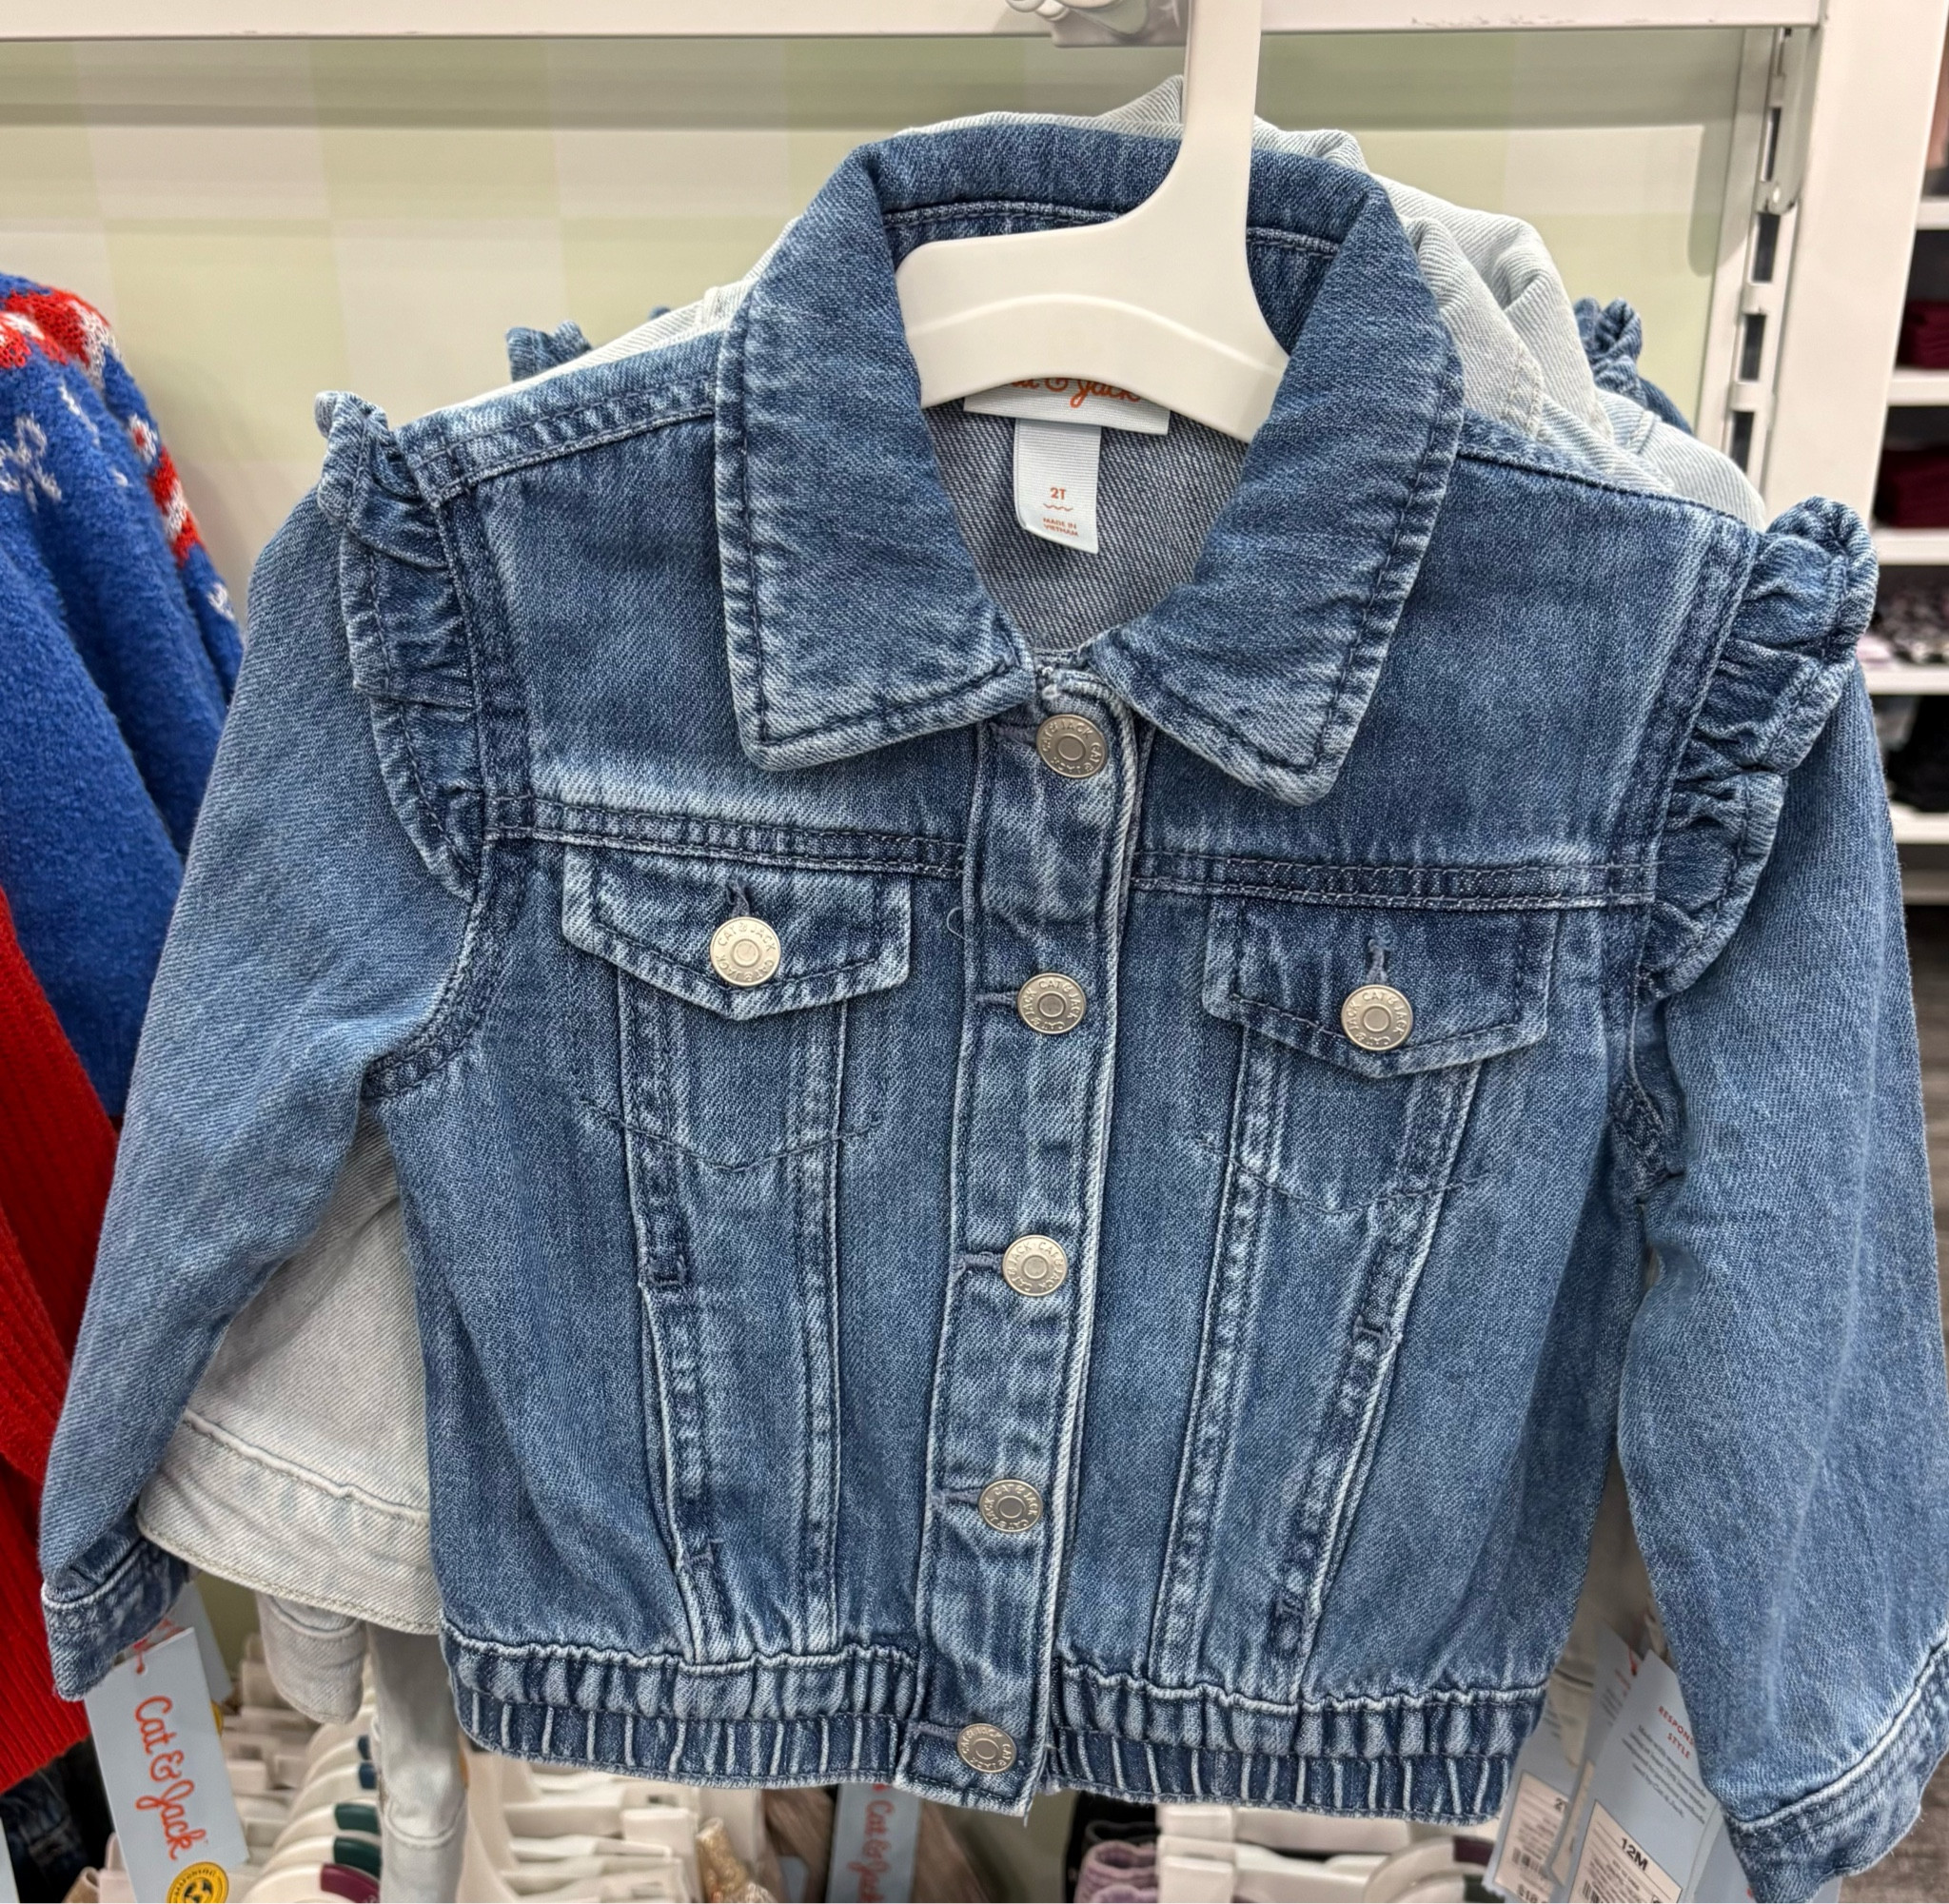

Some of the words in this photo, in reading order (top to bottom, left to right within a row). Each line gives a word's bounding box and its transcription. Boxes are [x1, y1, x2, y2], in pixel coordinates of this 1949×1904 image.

[1050, 487, 1066, 500] 2T
[1043, 518, 1065, 527] MADE
[1043, 523, 1079, 537] VIETNAM
[135, 1696, 177, 1755] Cat
[1666, 1733, 1691, 1758] STYLE
[149, 1750, 185, 1782] &
[135, 1779, 207, 1860] Jack
[1621, 1838, 1648, 1871] 12M
